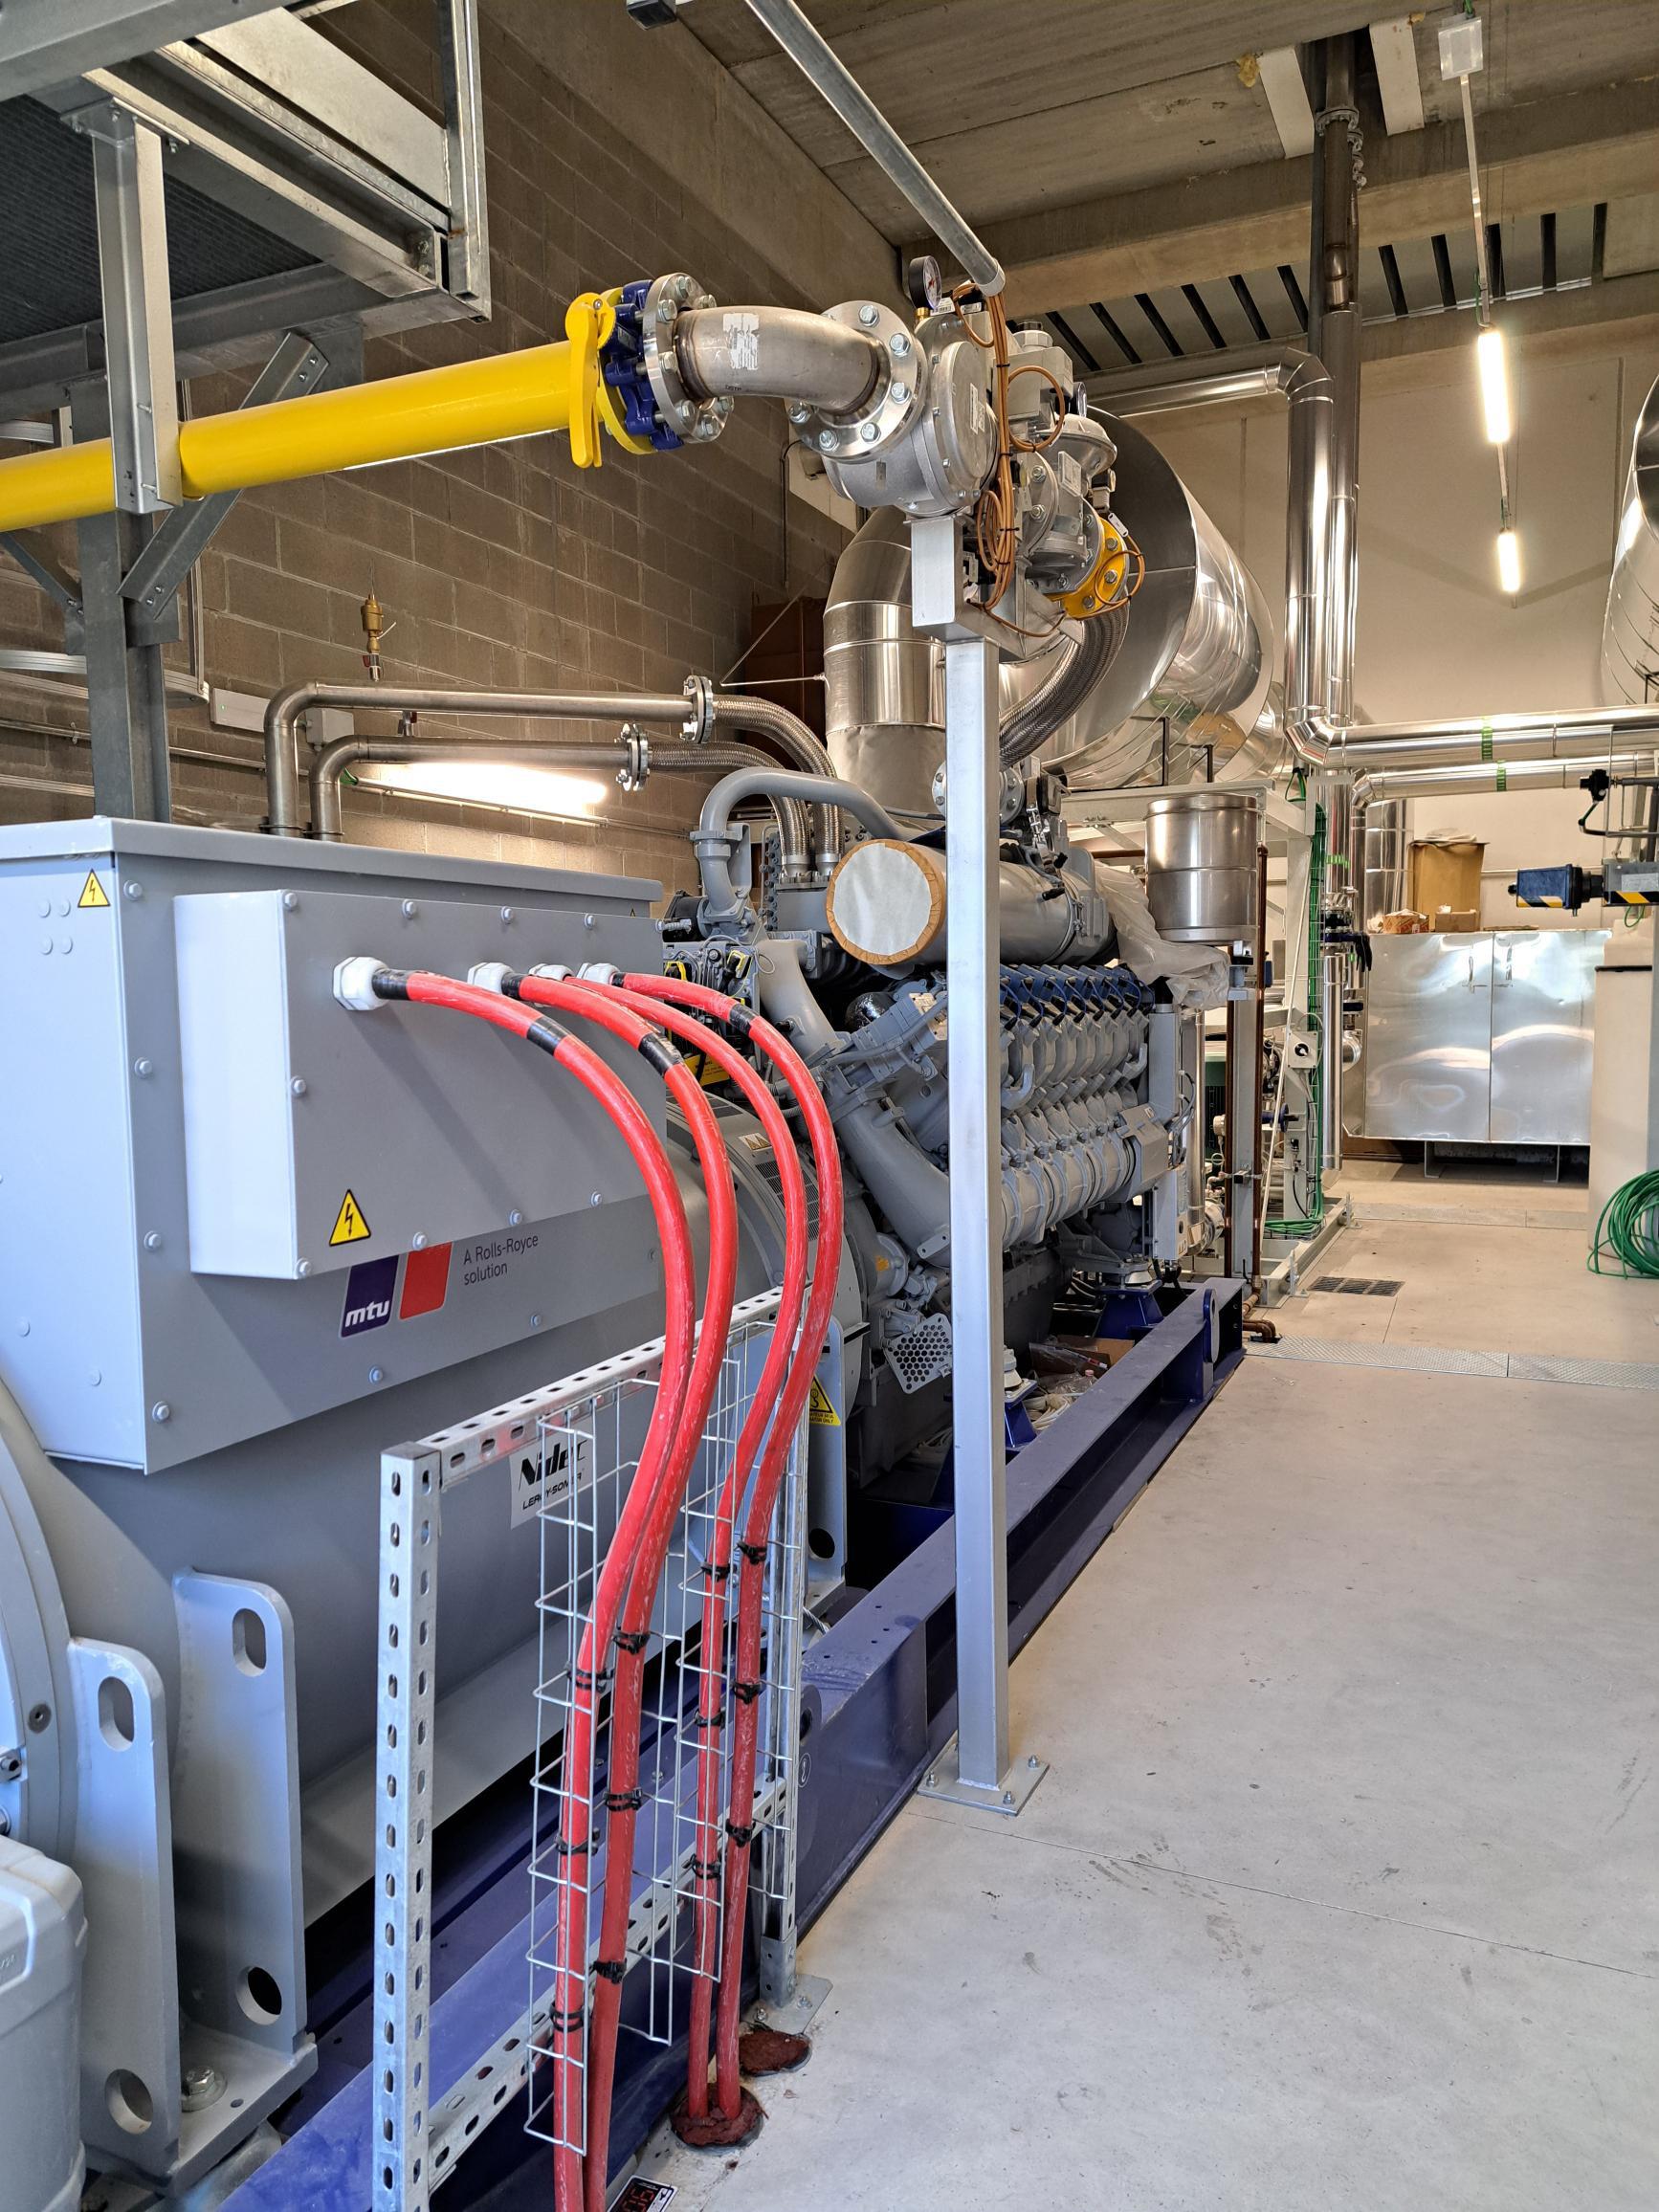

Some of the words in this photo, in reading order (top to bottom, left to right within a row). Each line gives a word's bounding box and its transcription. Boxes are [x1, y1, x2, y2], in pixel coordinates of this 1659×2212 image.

[464, 1249, 472, 1265] A
[476, 1235, 539, 1261] Rolls-Royce
[464, 1263, 508, 1286] solution
[345, 1300, 390, 1327] mtu
